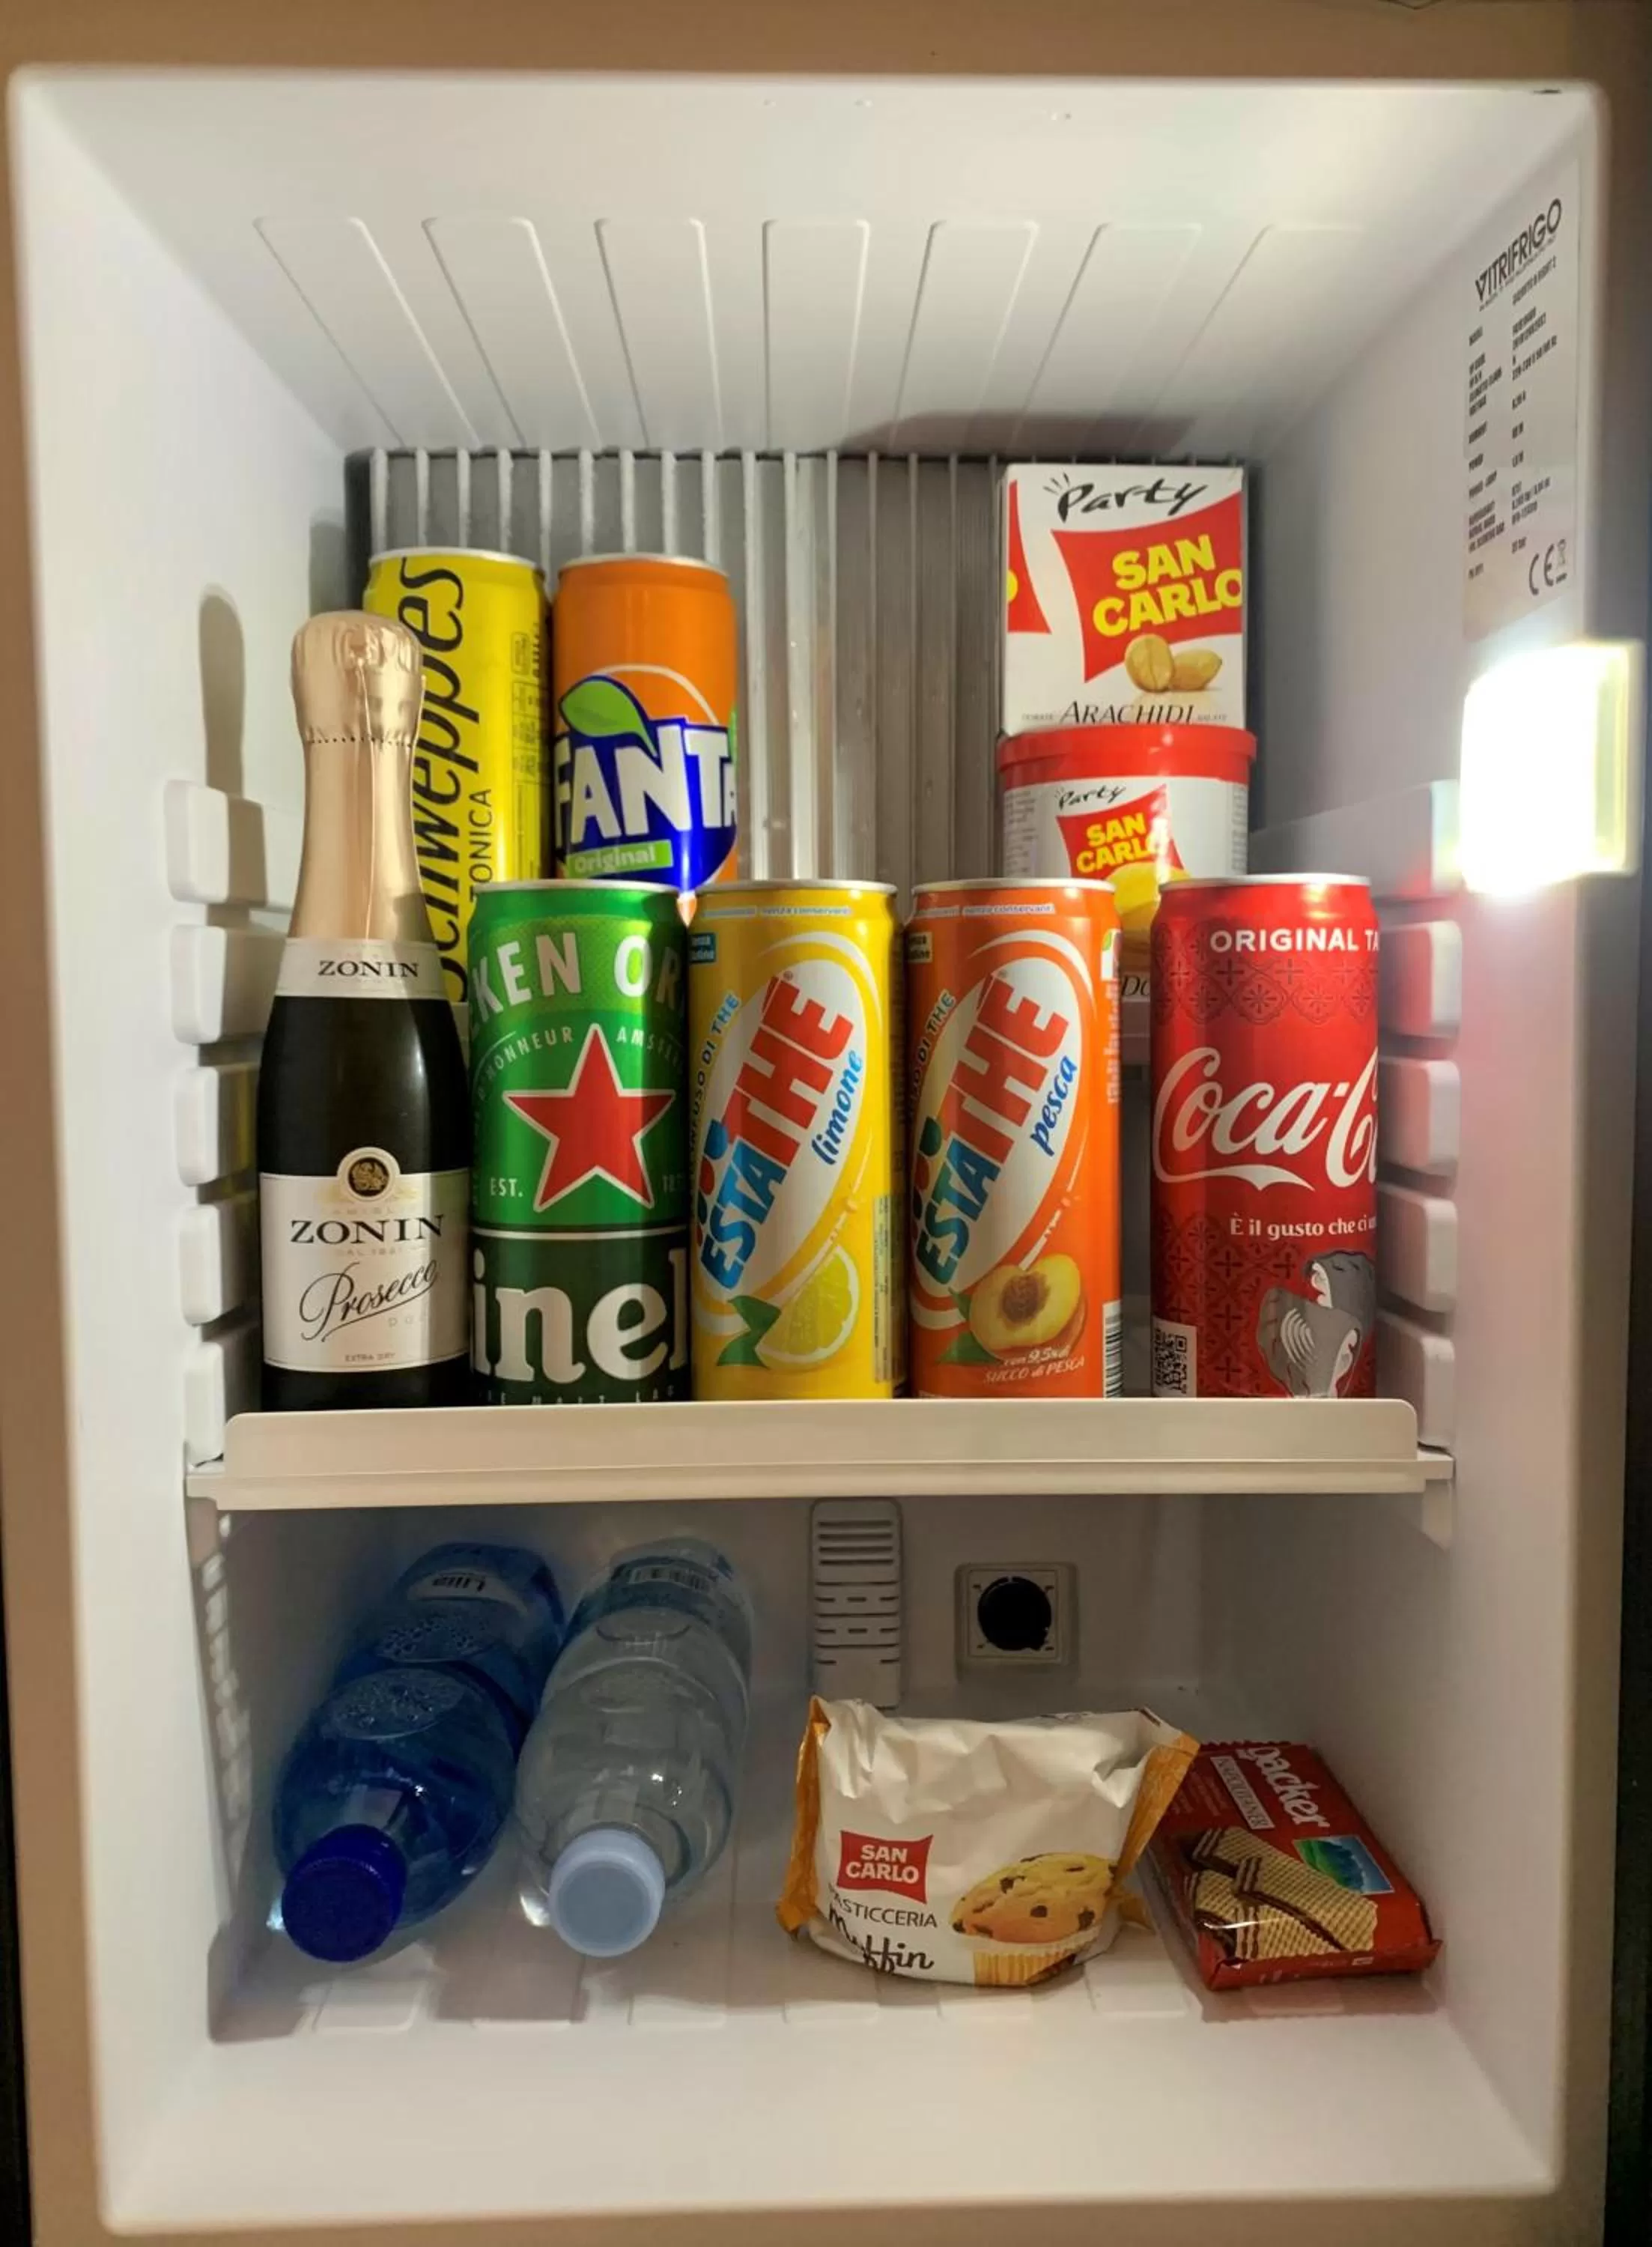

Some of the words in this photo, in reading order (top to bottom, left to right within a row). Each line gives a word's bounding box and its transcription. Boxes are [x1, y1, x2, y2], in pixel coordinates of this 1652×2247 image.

[1474, 197, 1562, 302] VITRIFRIGO
[1057, 478, 1208, 523] Party
[1111, 534, 1215, 590] SAN
[1092, 568, 1242, 637] CARLO
[1058, 700, 1196, 724] ARACHIDI
[1057, 785, 1126, 810] Party
[1086, 812, 1147, 848] SAN
[574, 845, 656, 873] Original
[1209, 927, 1360, 953] ORIGINAL
[317, 959, 420, 978] ZONIN
[702, 1040, 717, 1065] DI
[811, 1049, 864, 1166] limone
[1030, 1055, 1078, 1157] pesca
[491, 1177, 524, 1198] EST.
[290, 1213, 445, 1245] ZONIN
[1248, 1218, 1263, 1236] il
[1267, 1222, 1325, 1241] gusto
[1328, 1217, 1355, 1235] che
[299, 1259, 438, 1343] Prosecco
[344, 1353, 374, 1362] EXTRA
[984, 1367, 1030, 1384] SUCCO
[1045, 1355, 1085, 1375] PESCA
[860, 1843, 908, 1864] SAN
[845, 1861, 920, 1884] CARLO
